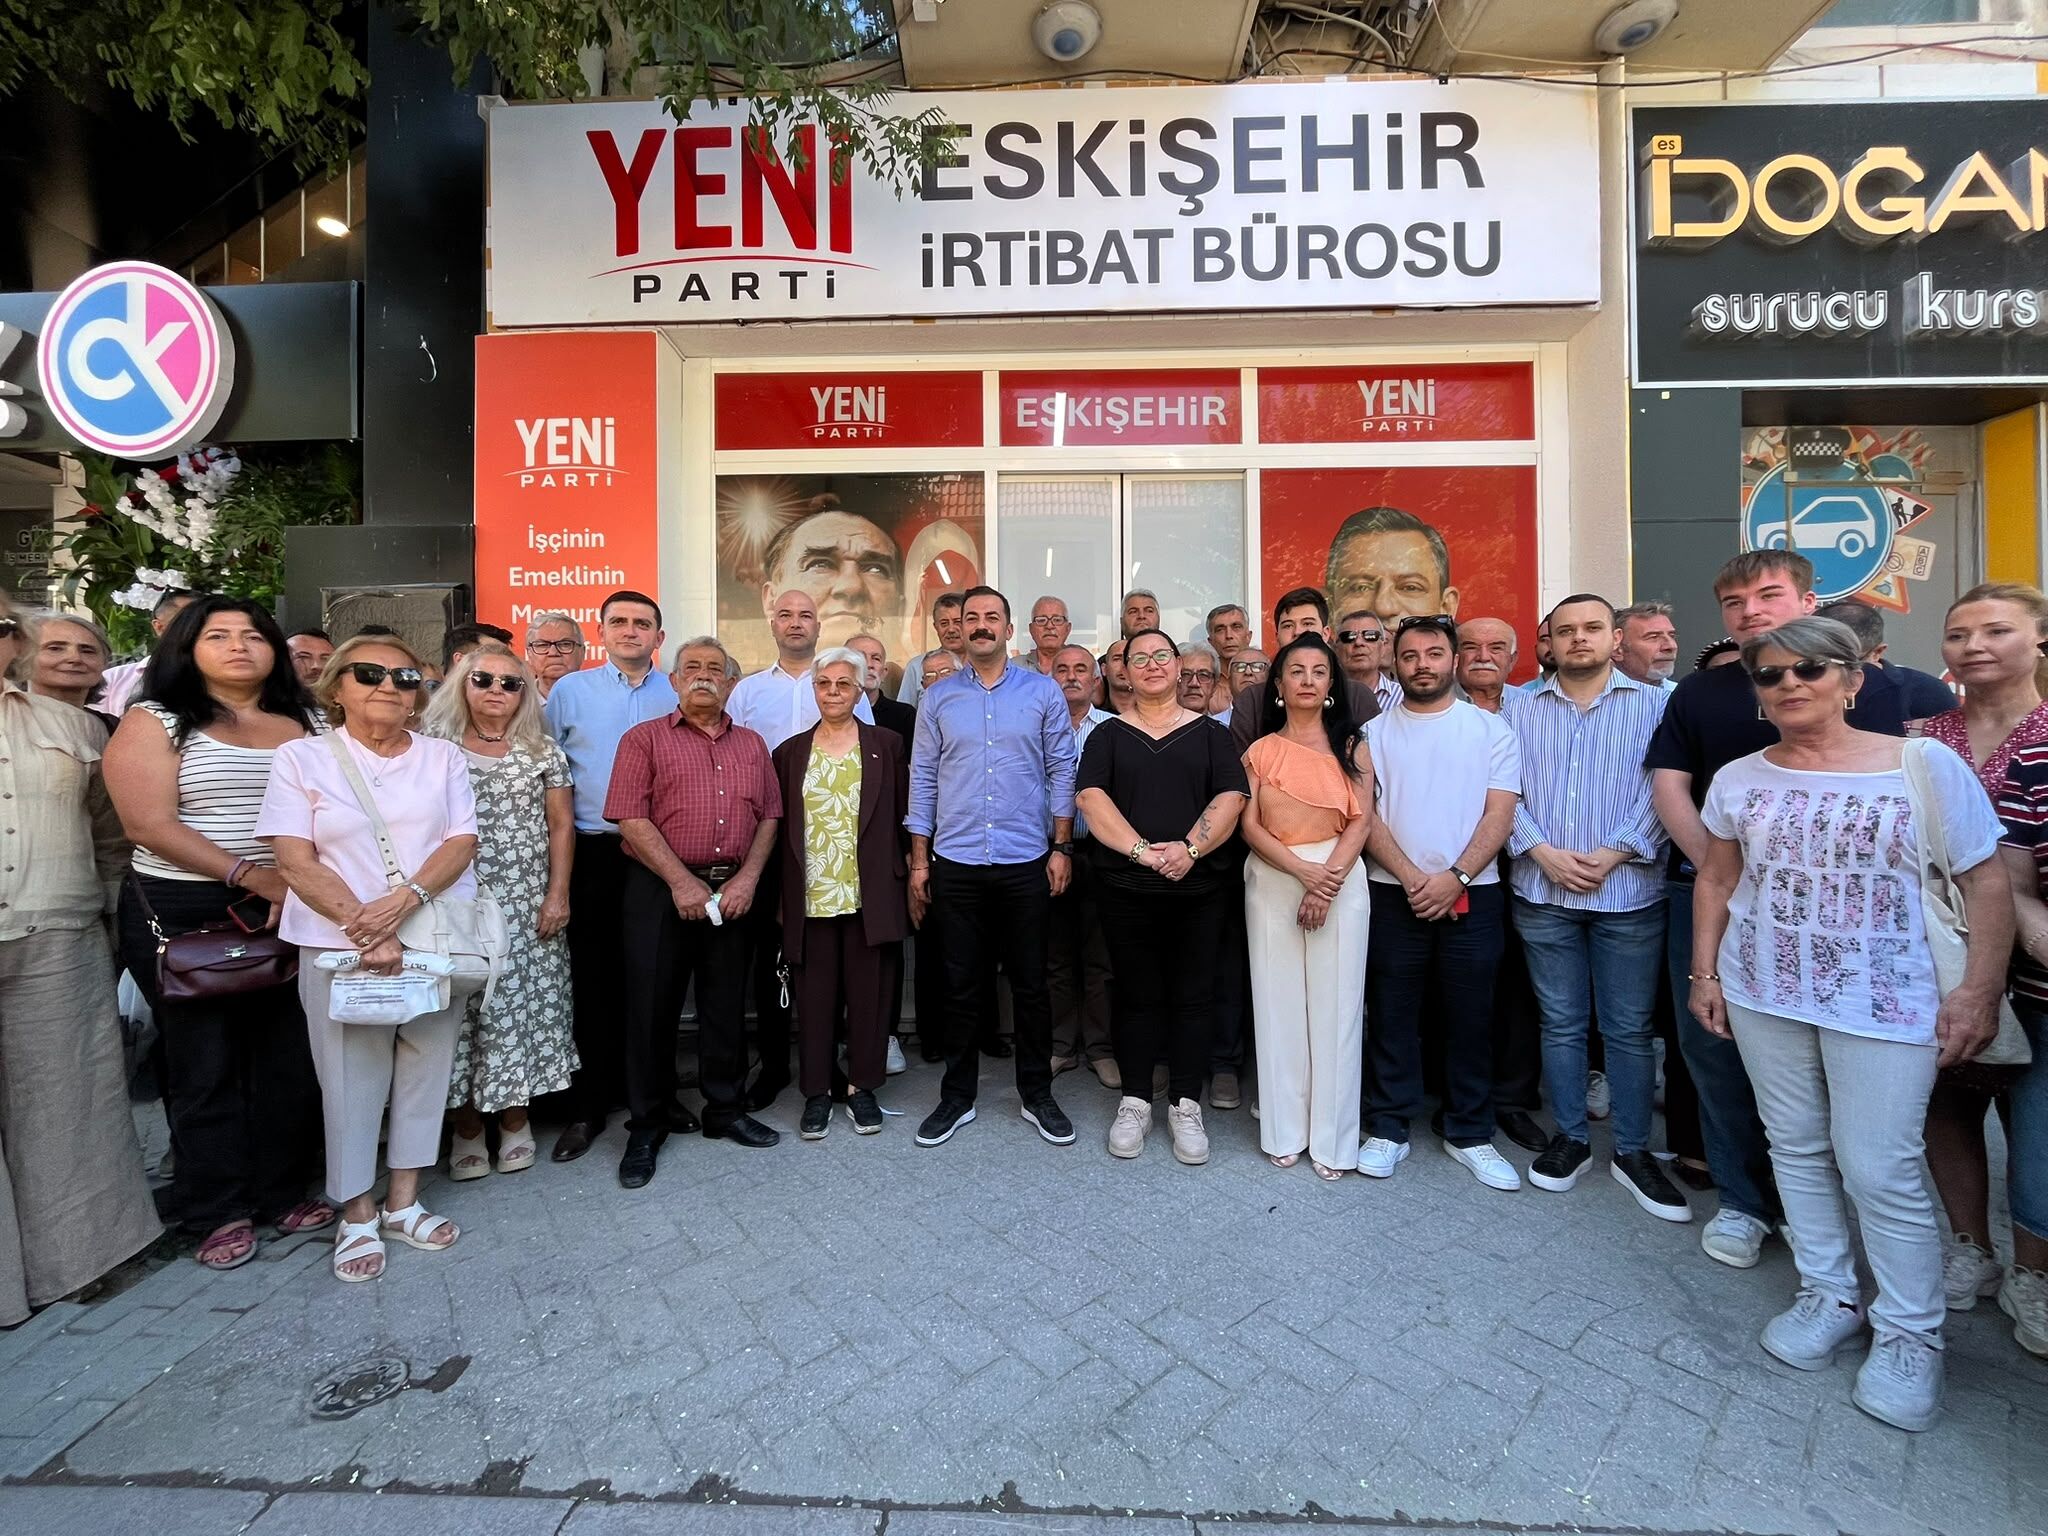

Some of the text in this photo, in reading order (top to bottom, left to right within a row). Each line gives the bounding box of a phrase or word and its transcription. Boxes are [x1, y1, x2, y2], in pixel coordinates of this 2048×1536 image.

[1657, 139, 1676, 151] es
[1651, 147, 2048, 237] DOĞA
[1193, 212, 1499, 283] BÜROSU
[528, 524, 605, 554] İşçinin
[508, 565, 626, 588] Emeklinin
